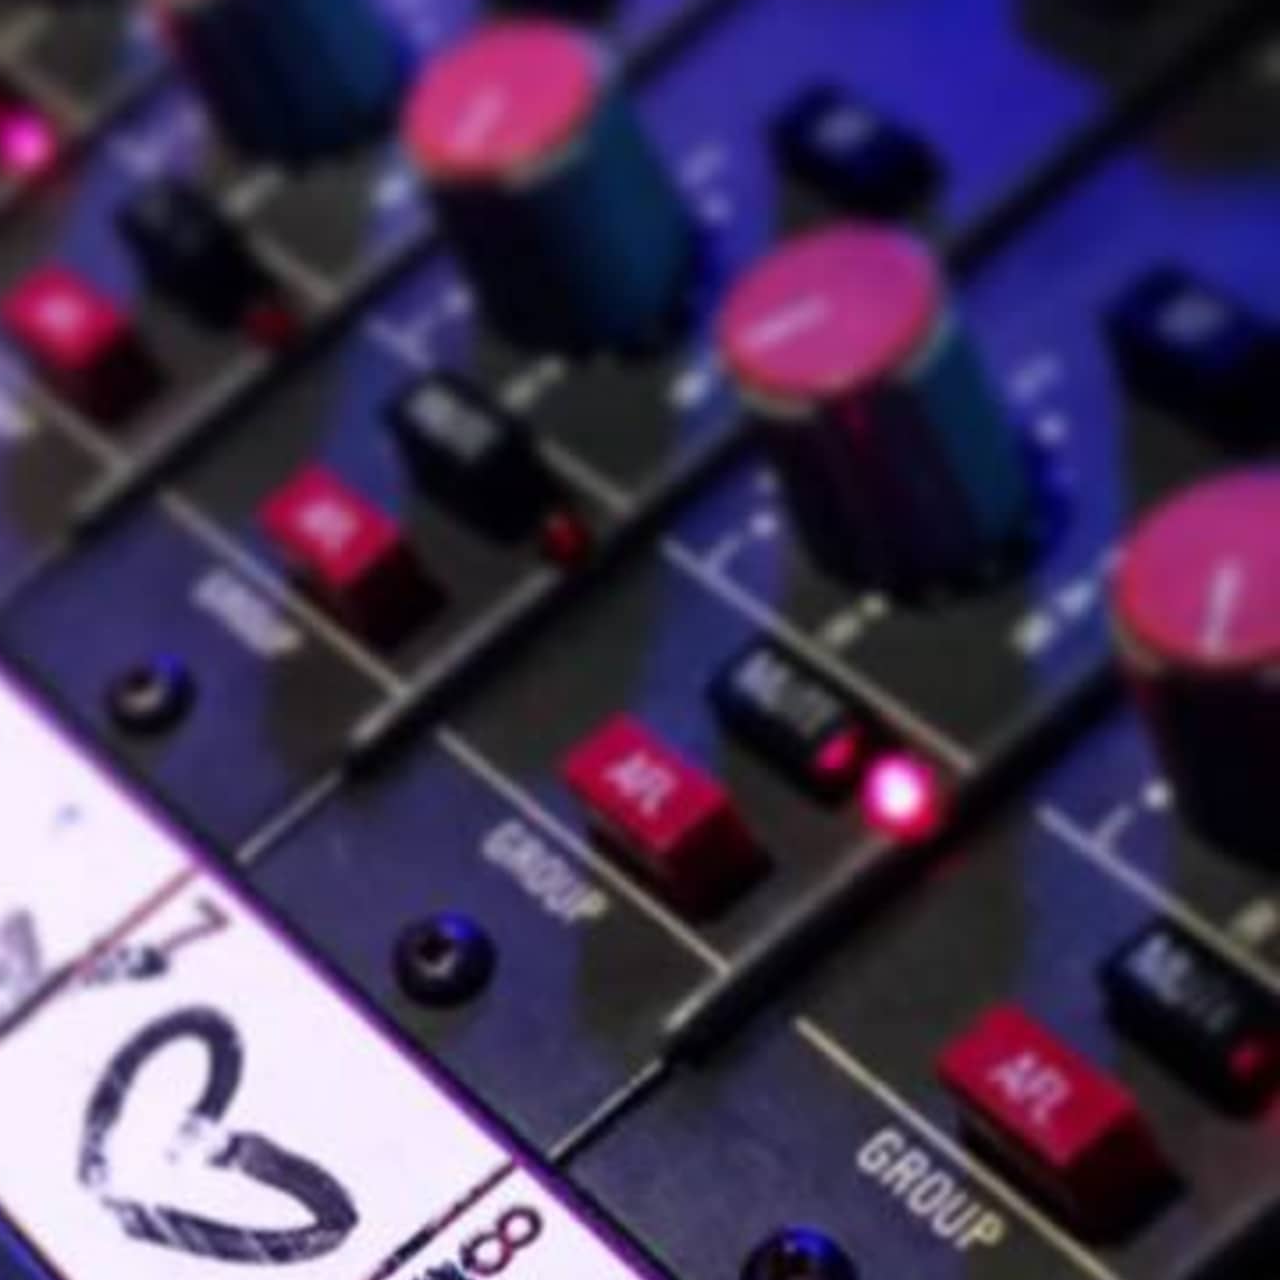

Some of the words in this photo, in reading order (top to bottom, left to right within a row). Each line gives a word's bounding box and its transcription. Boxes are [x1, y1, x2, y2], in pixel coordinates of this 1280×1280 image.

[480, 821, 608, 920] GROUP
[986, 1051, 1071, 1126] AFL
[855, 1128, 1009, 1250] GROUP
[460, 1206, 544, 1277] 8
